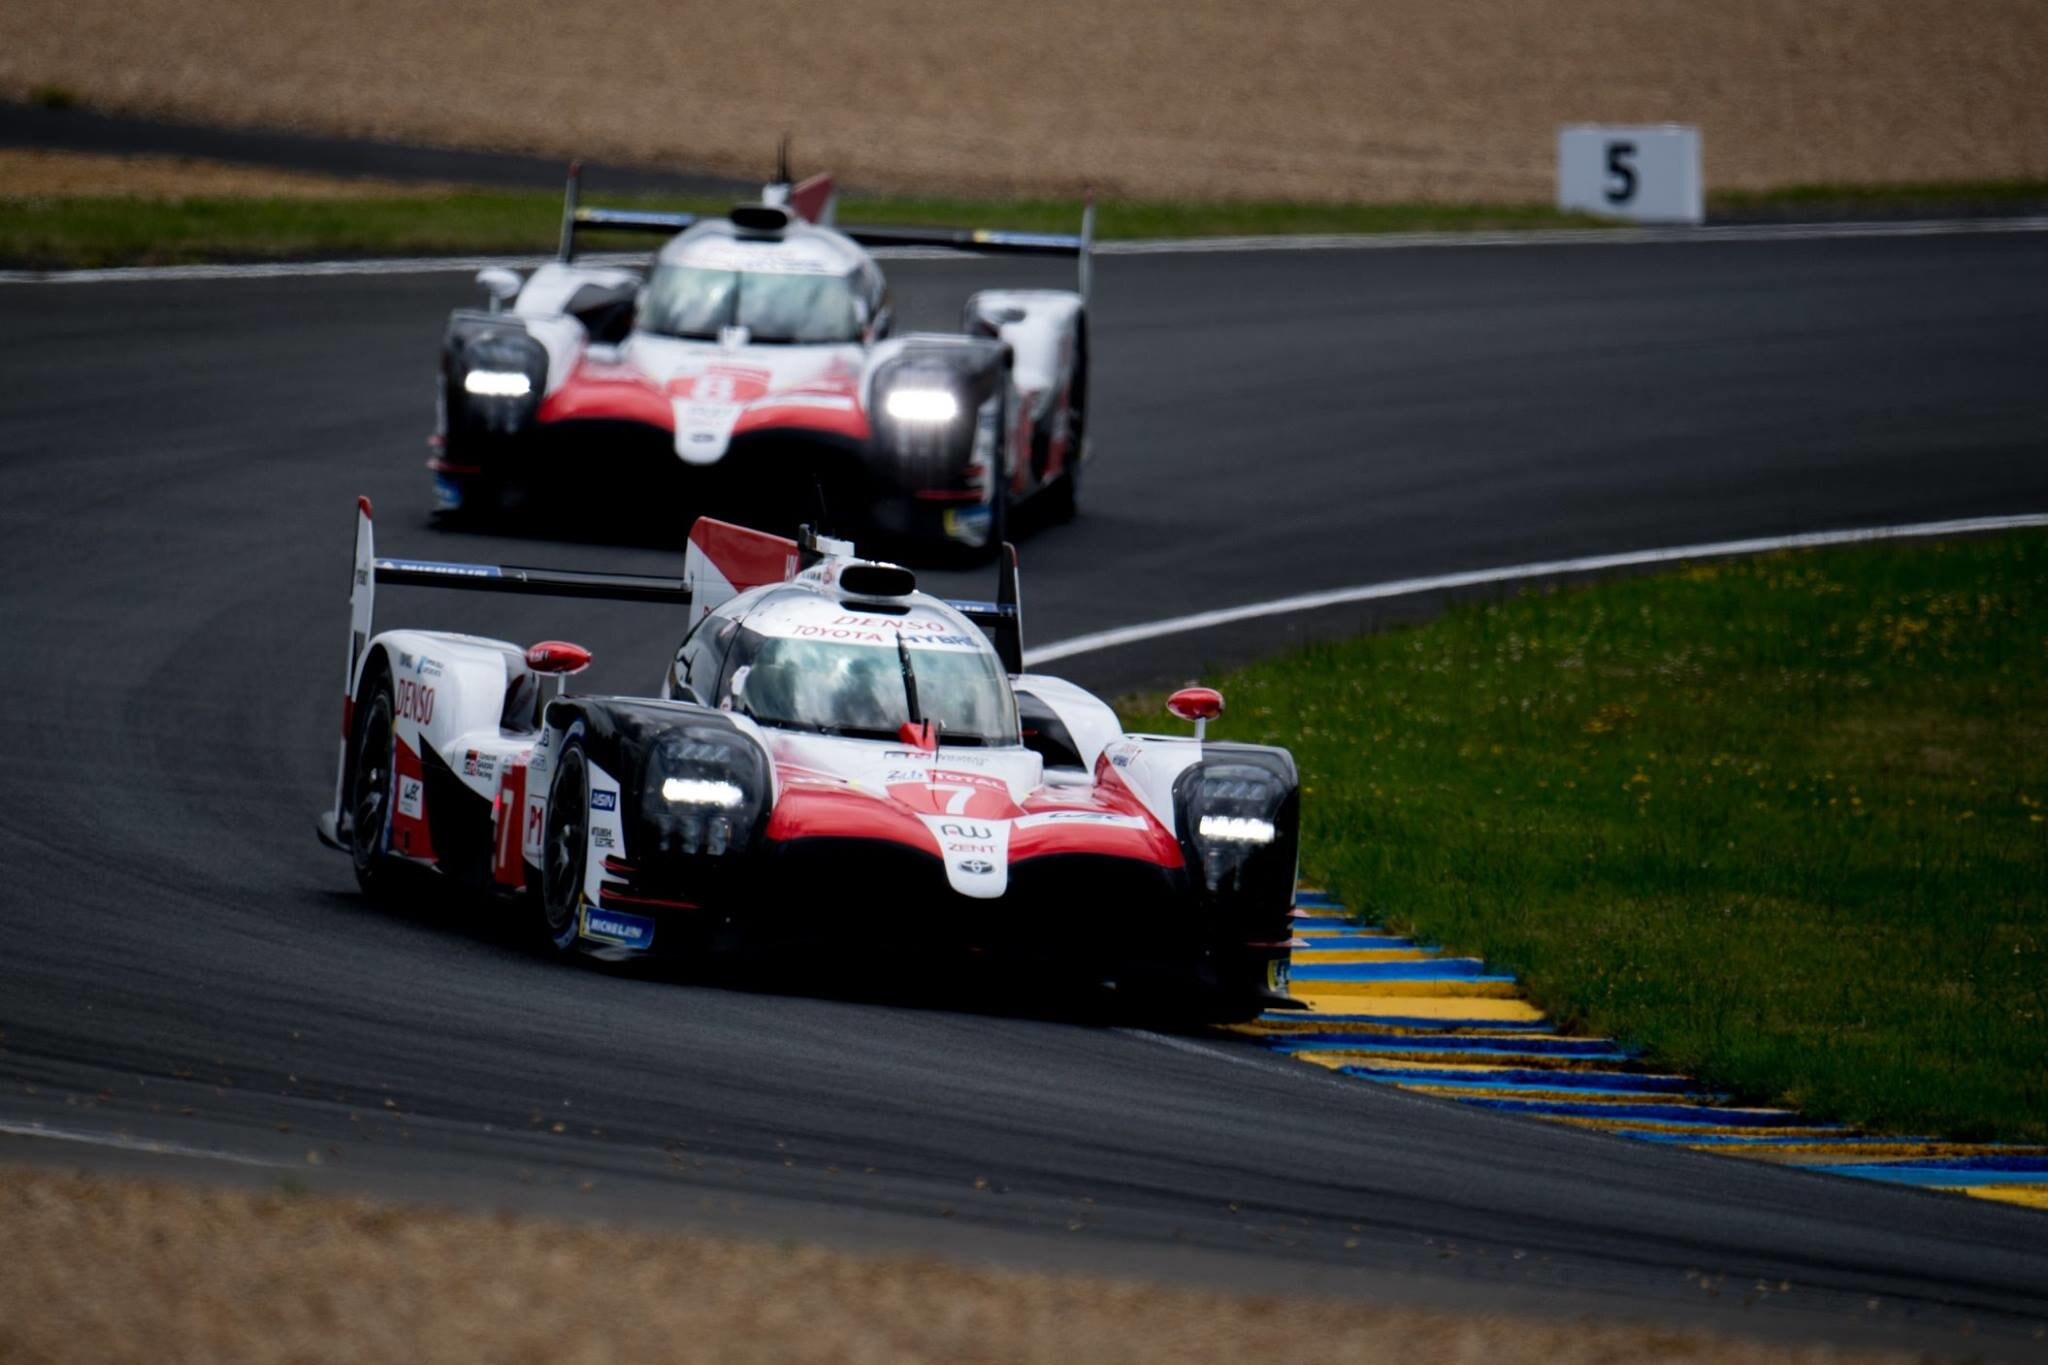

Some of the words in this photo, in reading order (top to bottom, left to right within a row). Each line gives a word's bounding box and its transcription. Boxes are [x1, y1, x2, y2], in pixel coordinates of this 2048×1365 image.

[1605, 140, 1639, 206] 5
[793, 625, 884, 642] TOYOTA
[834, 615, 945, 632] DENSO
[395, 678, 435, 726] DENSO
[932, 771, 1006, 792] TOTAL
[925, 783, 976, 815] 7
[528, 805, 543, 845] P1
[948, 843, 998, 854] ZENT
[590, 918, 643, 938] MICHELIN
